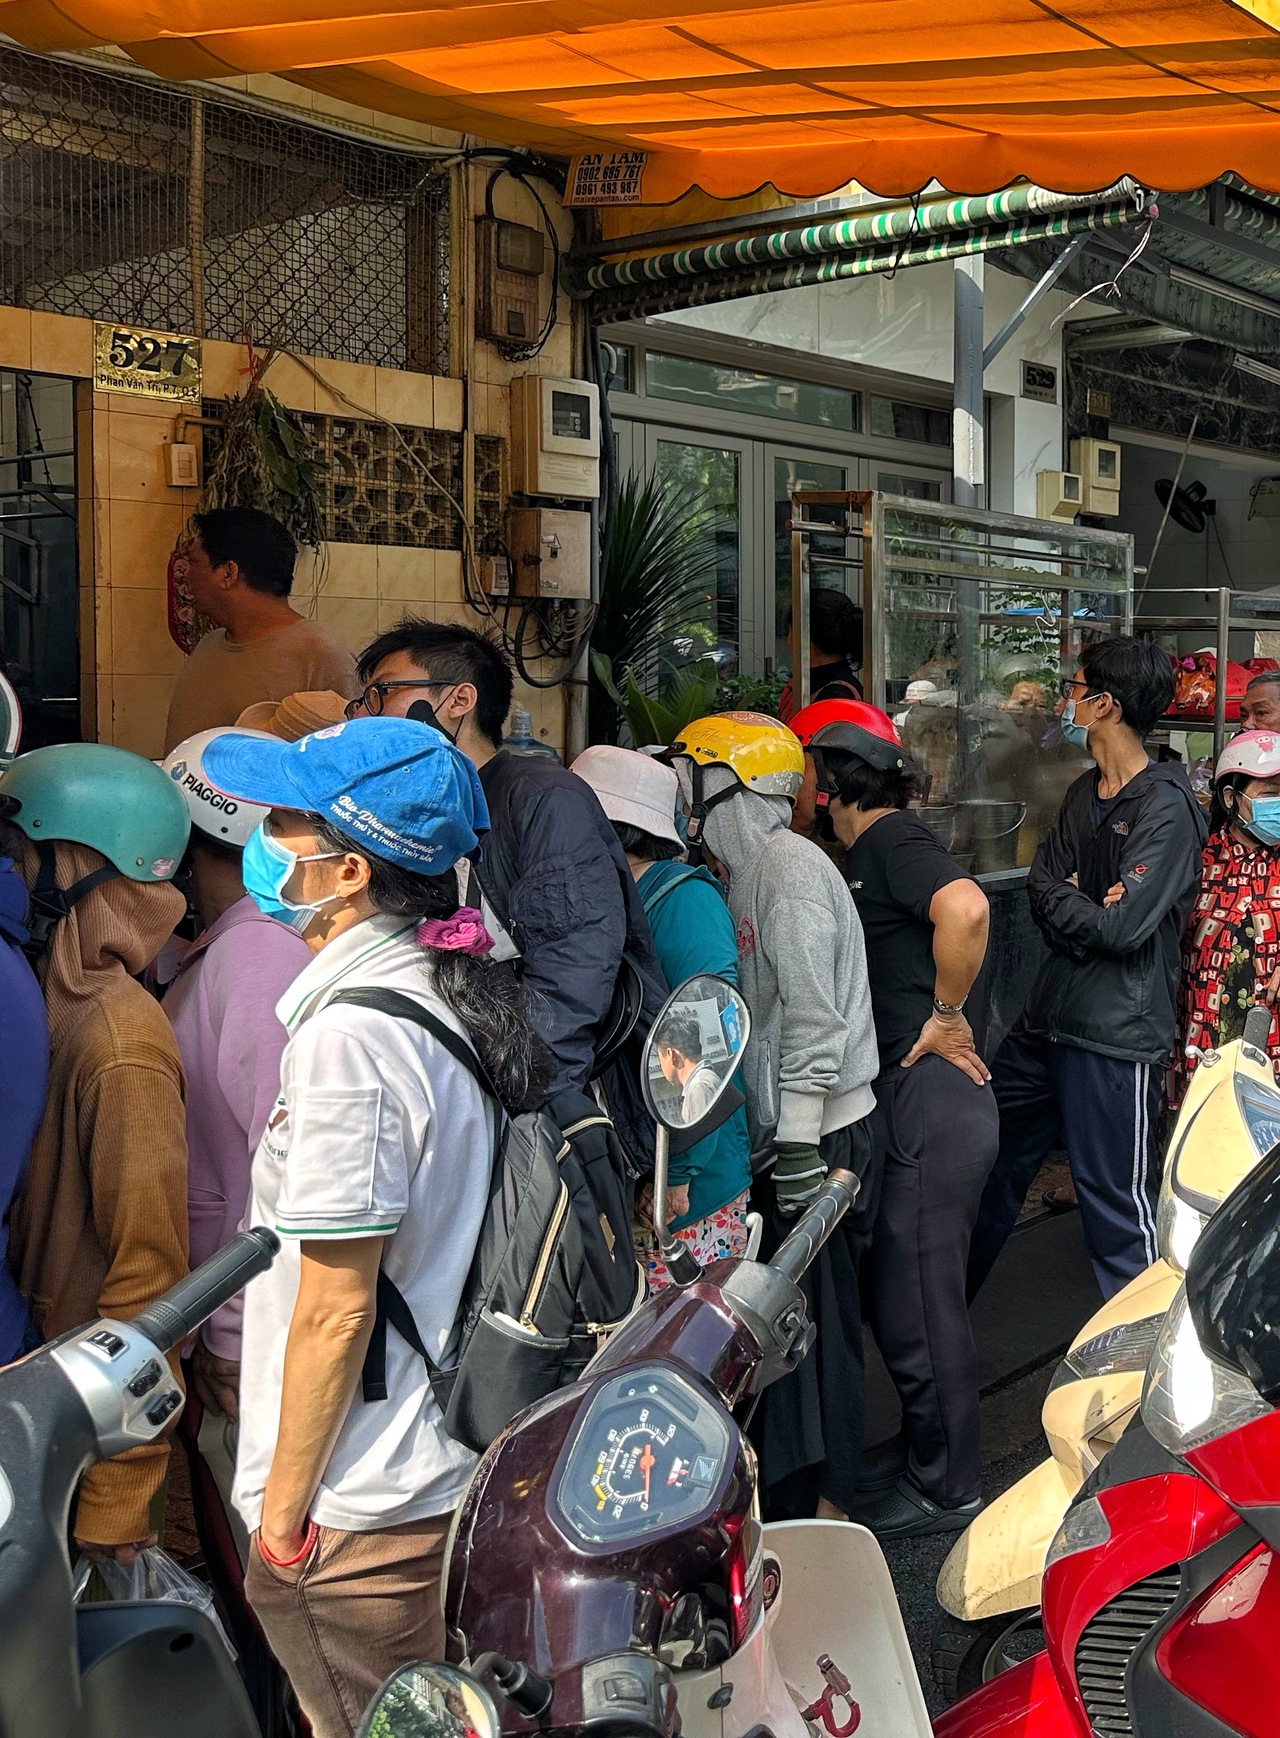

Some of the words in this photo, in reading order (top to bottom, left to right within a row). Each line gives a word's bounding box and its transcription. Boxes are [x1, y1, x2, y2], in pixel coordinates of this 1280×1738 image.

[577, 167, 600, 181] 0902
[603, 166, 621, 180] 695
[623, 165, 641, 178] 761
[576, 183, 597, 195] 0961
[600, 182, 617, 194] 493
[620, 181, 638, 193] 987
[109, 332, 189, 376] 527
[100, 375, 124, 387] Phan
[1026, 366, 1055, 389] 529
[182, 772, 238, 815] PIAGGIO
[612, 1505, 623, 1519] 20
